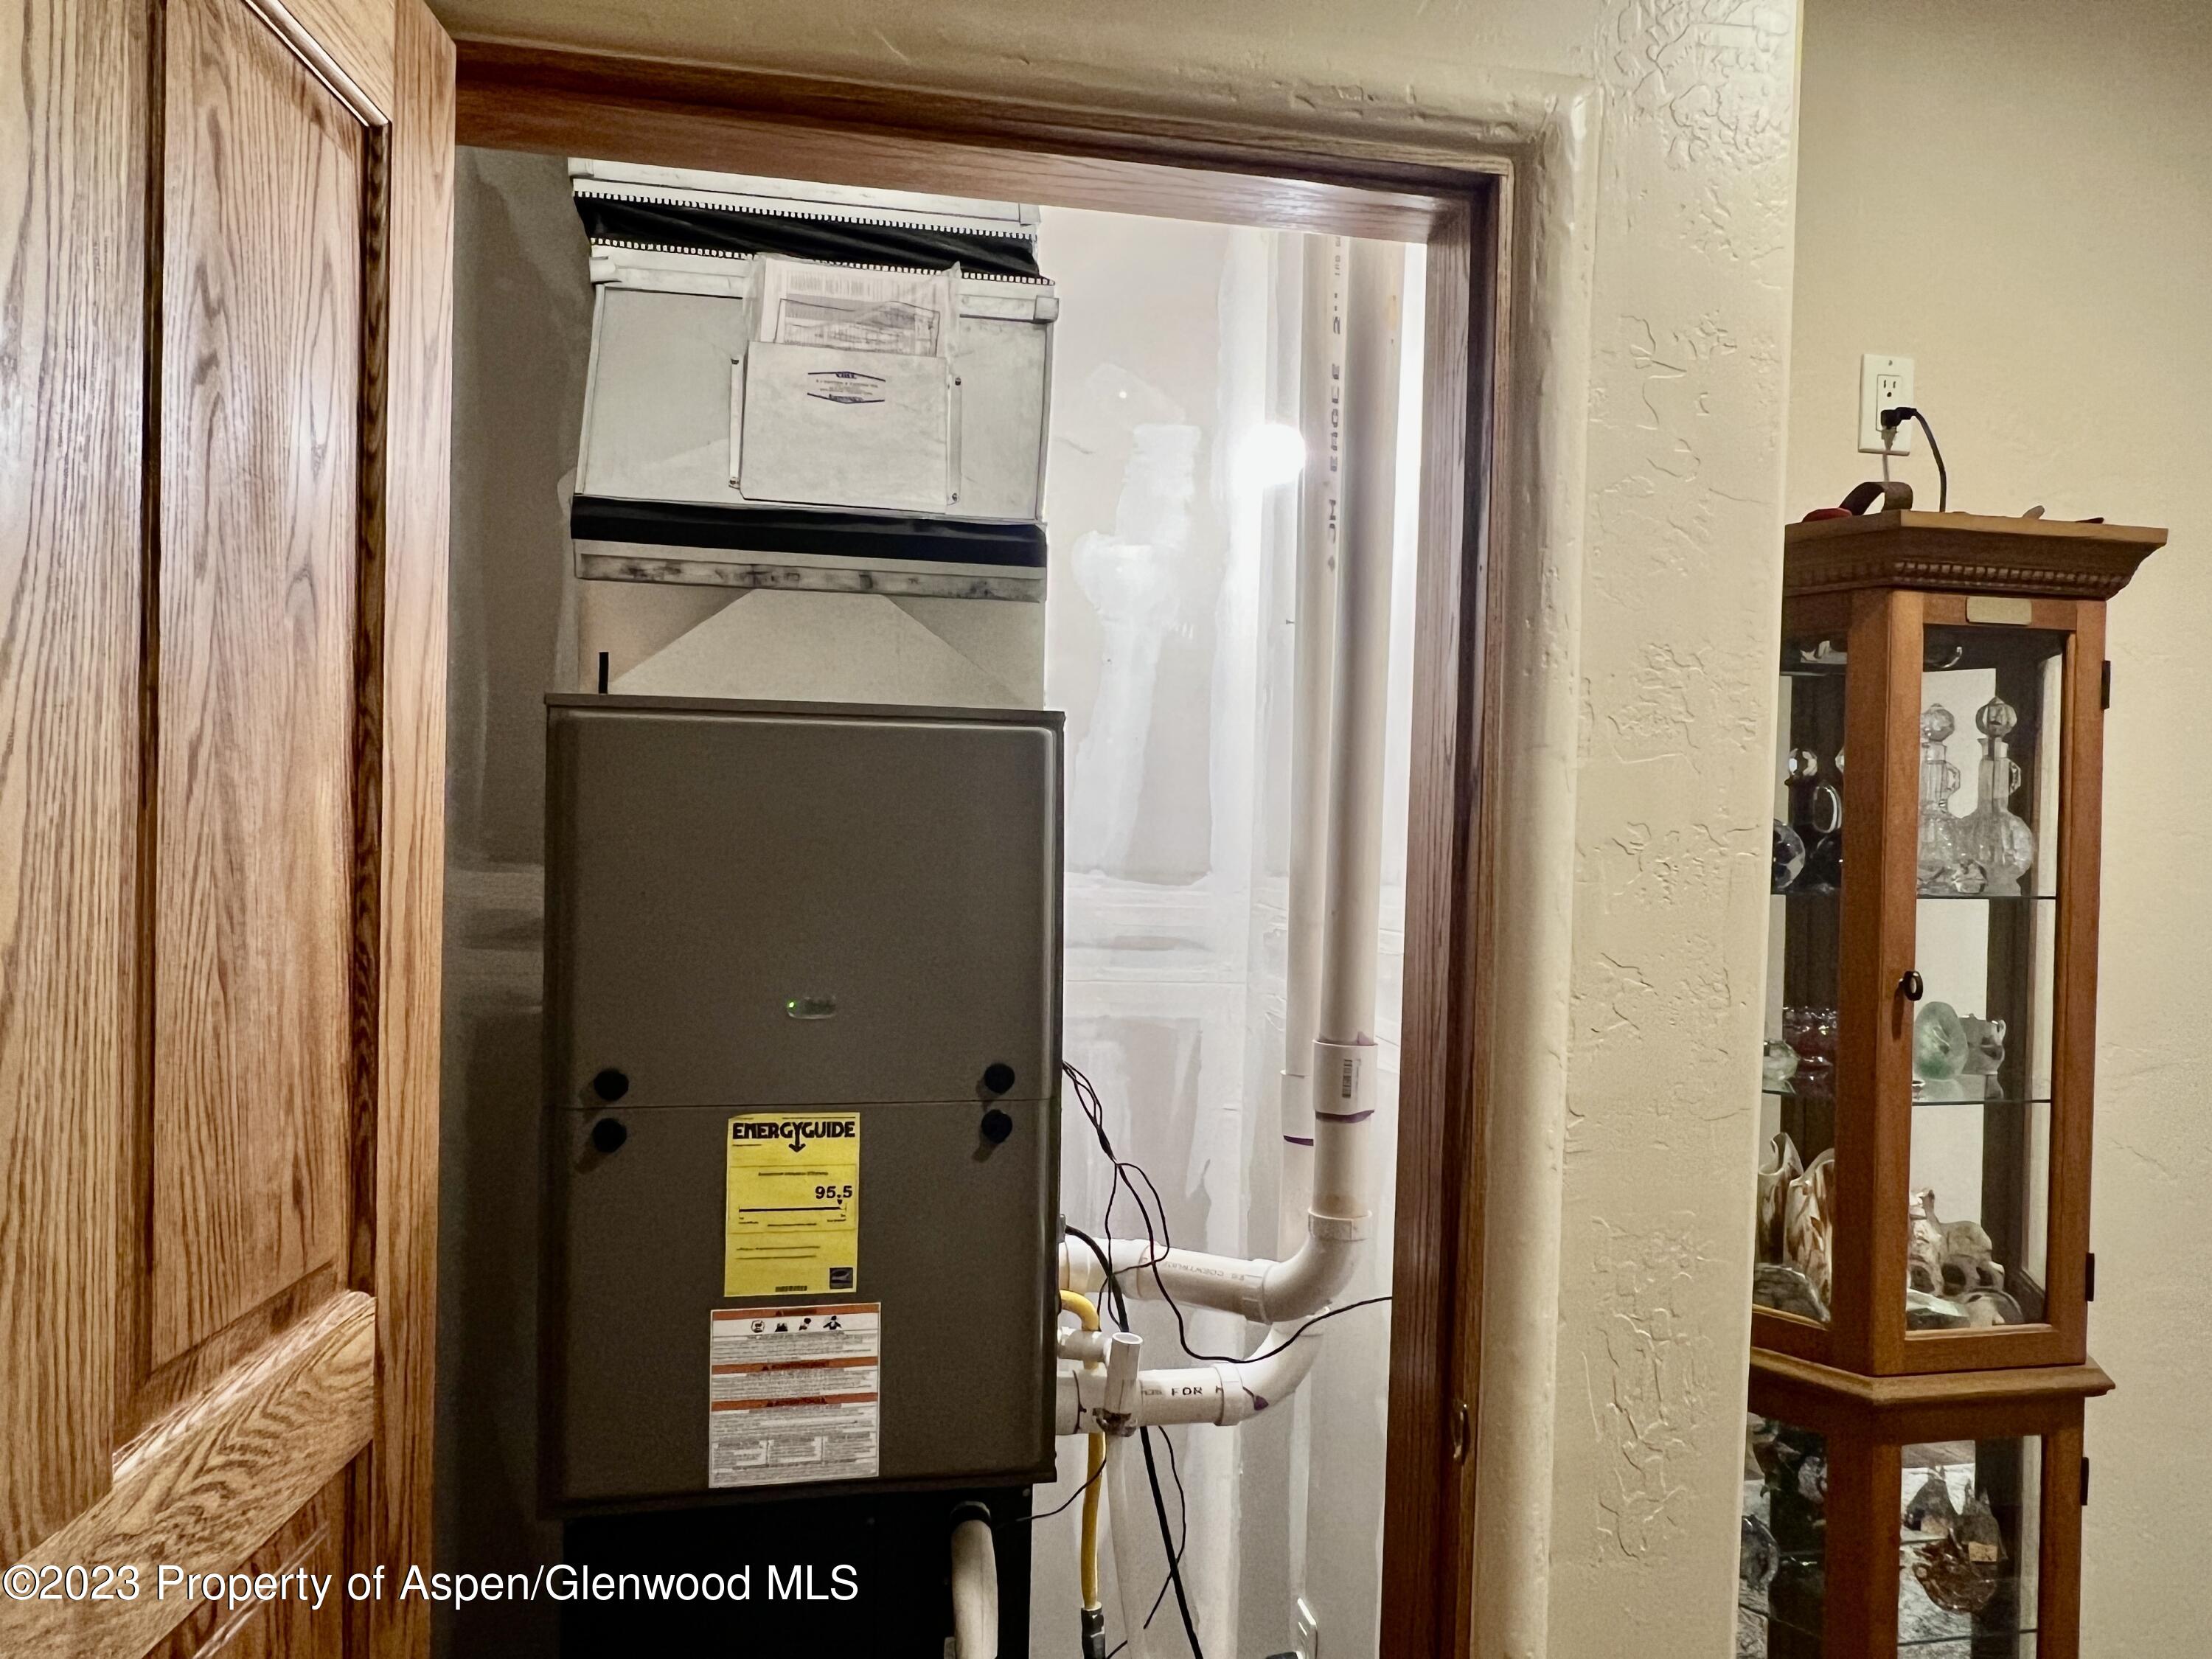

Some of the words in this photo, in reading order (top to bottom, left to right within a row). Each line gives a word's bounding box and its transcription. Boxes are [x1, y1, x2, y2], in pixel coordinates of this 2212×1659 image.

[732, 1121, 855, 1142] ENERGYGUIDE
[815, 1185, 853, 1200] 95.5
[1171, 1386, 1203, 1397] FOR
